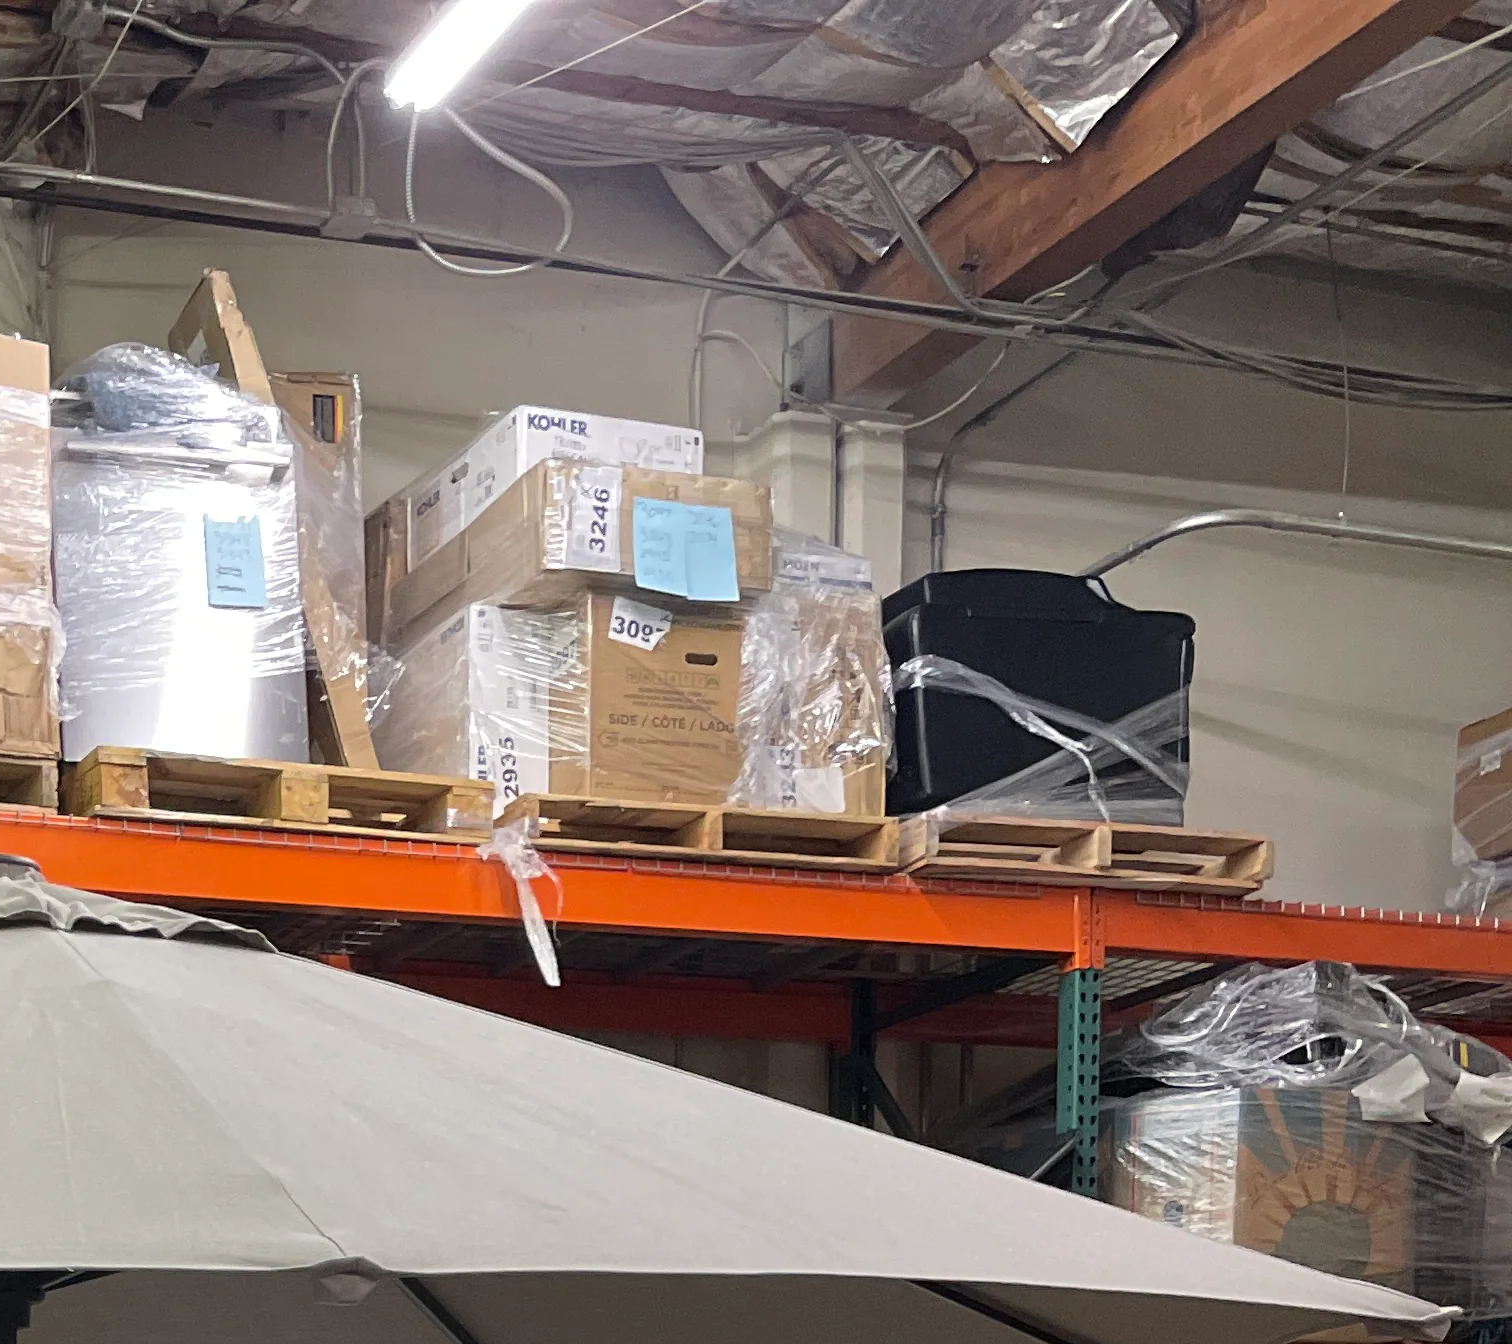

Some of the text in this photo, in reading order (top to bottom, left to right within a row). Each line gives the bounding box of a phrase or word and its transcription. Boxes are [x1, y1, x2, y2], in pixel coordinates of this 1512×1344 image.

[589, 487, 610, 553] 3246
[608, 713, 638, 727] SIDE
[498, 736, 520, 799] 2935
